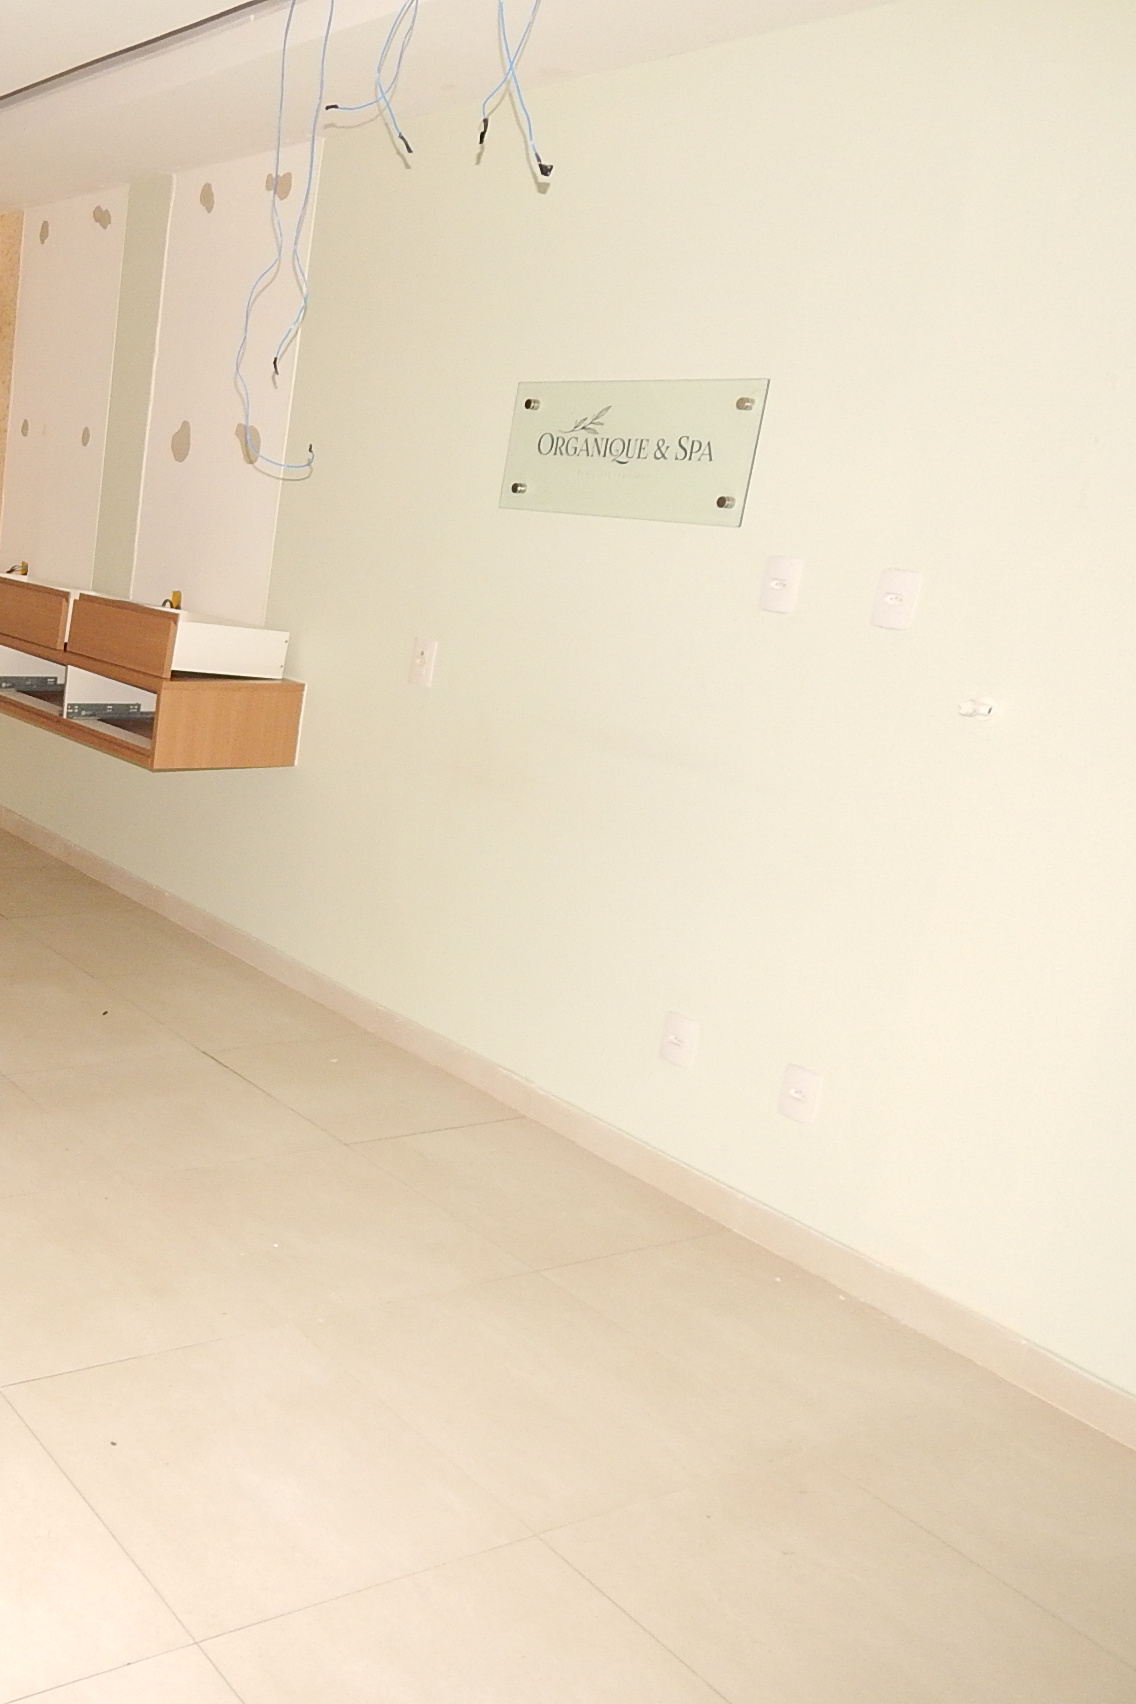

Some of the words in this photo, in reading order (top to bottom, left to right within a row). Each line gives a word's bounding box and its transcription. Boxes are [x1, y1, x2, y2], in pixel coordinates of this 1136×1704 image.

[537, 432, 649, 464] ORGANIQUE
[653, 437, 670, 460] &
[674, 435, 713, 462] SPA
